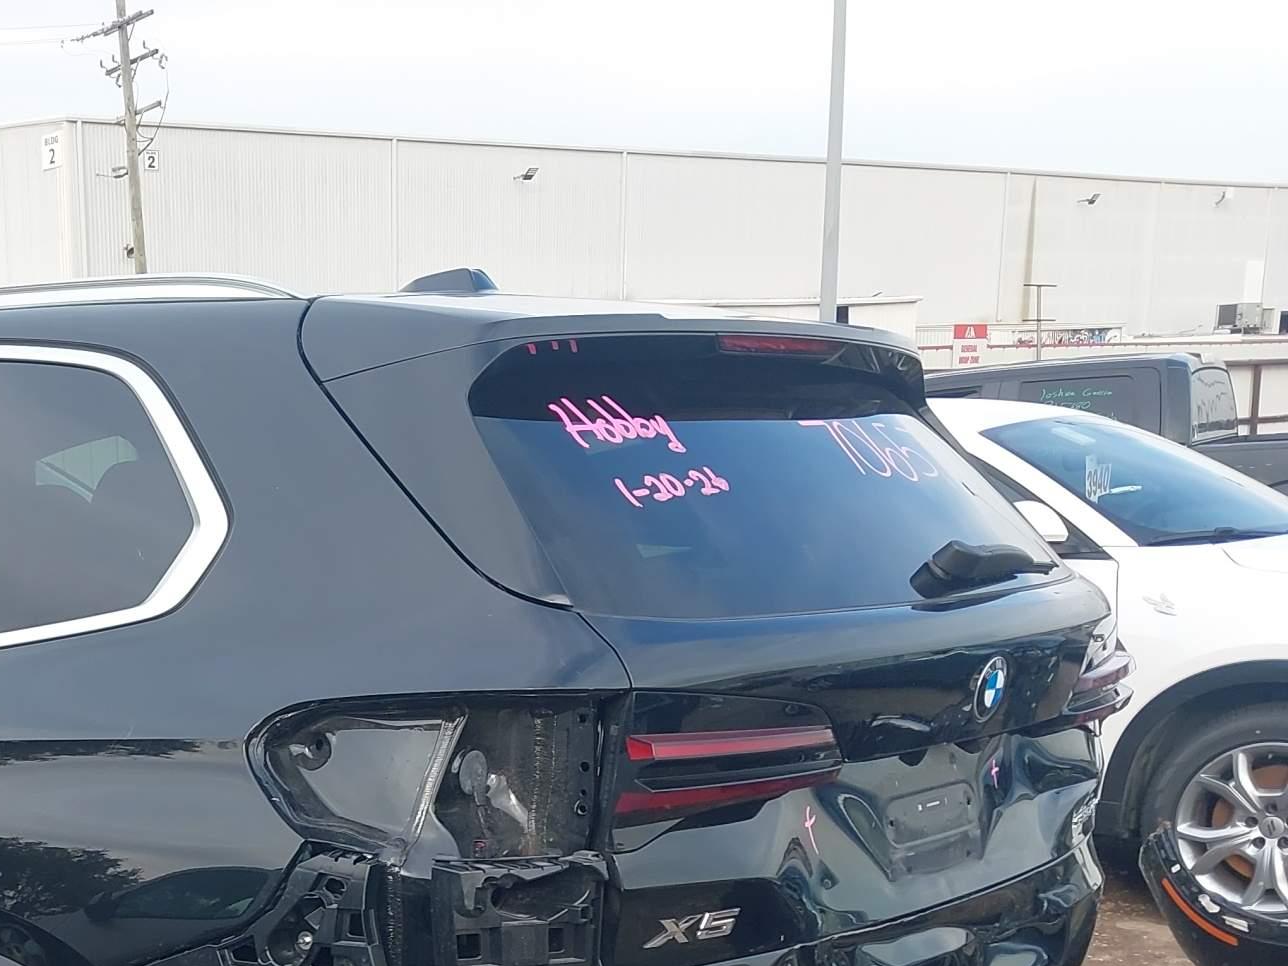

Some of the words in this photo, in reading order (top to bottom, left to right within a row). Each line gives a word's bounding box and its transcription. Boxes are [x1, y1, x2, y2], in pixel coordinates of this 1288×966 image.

[48, 148, 56, 164] 2
[147, 155, 156, 169] 2
[548, 395, 687, 453] Hobby
[642, 907, 741, 949] X5
